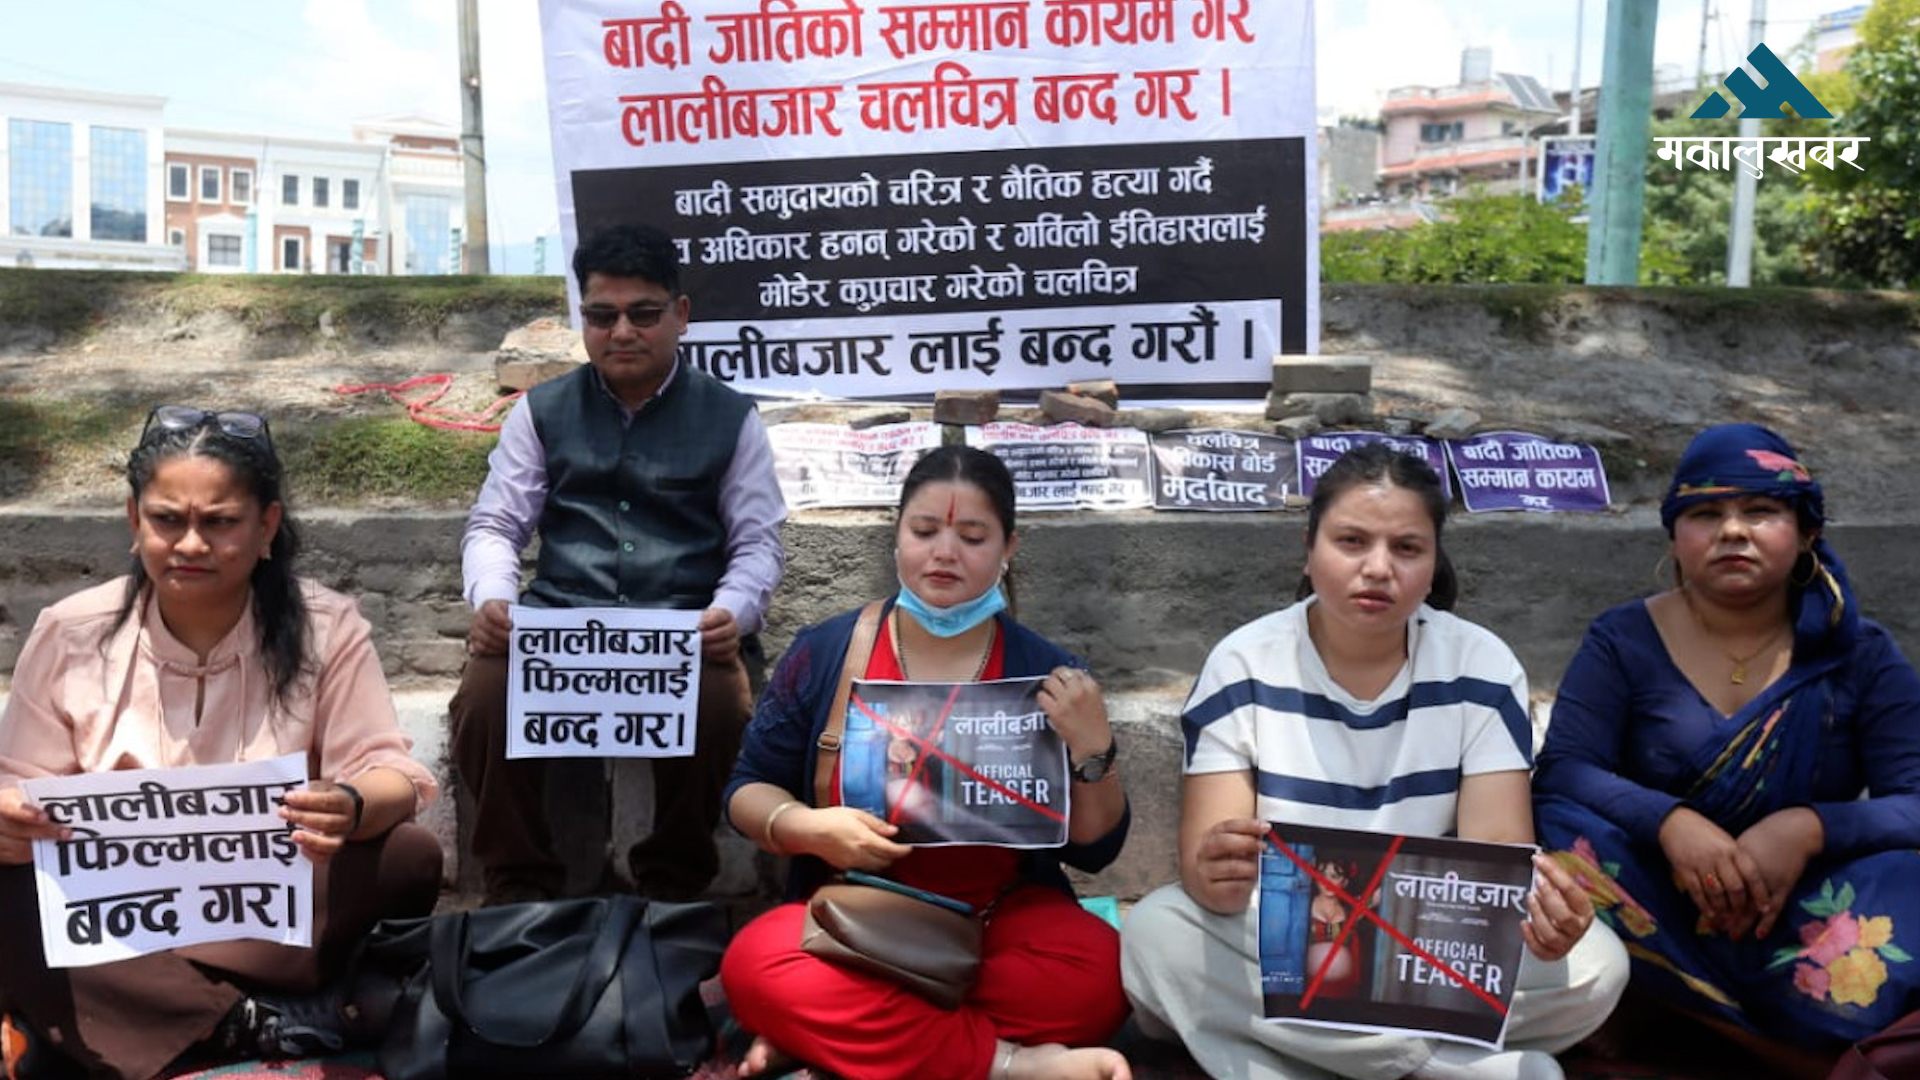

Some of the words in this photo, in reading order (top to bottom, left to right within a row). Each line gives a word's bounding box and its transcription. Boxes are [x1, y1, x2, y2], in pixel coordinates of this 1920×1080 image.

[602, 1, 691, 69] बादी
[705, 0, 864, 64] जातिको
[879, 0, 1029, 58] सम्मान
[1044, 0, 1176, 47] कायम
[1191, 0, 1255, 43] गर
[618, 75, 843, 146] लालीबजार
[857, 62, 1019, 133] चलचित्र
[1033, 73, 1119, 125] बन्द
[1134, 69, 1199, 121] गर
[675, 180, 732, 216] बादी
[741, 172, 880, 220] समुदायको
[888, 168, 963, 206] चरित्र
[971, 176, 992, 204] र
[1001, 163, 1083, 200] नैतिक
[1091, 168, 1161, 200] हत्या
[700, 227, 811, 264] अधिकार
[820, 229, 891, 260] हनन्
[897, 218, 976, 255] गरेको
[985, 223, 1005, 252] र
[1014, 211, 1101, 248] गर्विलो
[1109, 205, 1267, 249] ईतिहासलाई
[758, 272, 831, 307] मोडेर
[839, 275, 938, 312] कुप्रचार
[946, 264, 1025, 300] गरेको
[1034, 259, 1138, 295] चलचित्र
[908, 318, 1003, 376] लाई
[1020, 324, 1116, 366] बन्द
[1187, 432, 1260, 449] चलचित्र
[1462, 440, 1505, 461] बादी
[1241, 451, 1279, 473] बोर्ड
[1460, 468, 1530, 488] सम्मान
[1534, 468, 1597, 489] कायम
[517, 620, 696, 656] लालीबजार
[522, 658, 692, 698] फिल्मलाई
[524, 712, 602, 748] बन्द
[951, 711, 1047, 735] लालीबजा
[973, 763, 1034, 779] OFFICIAL
[960, 779, 1049, 805] TEASER
[55, 820, 304, 876] फिल्मलाई
[1389, 871, 1526, 913] लालीबजार
[65, 888, 181, 945] बन्द
[1413, 938, 1487, 962] OFFICIAL
[1396, 954, 1502, 994] TEASER
